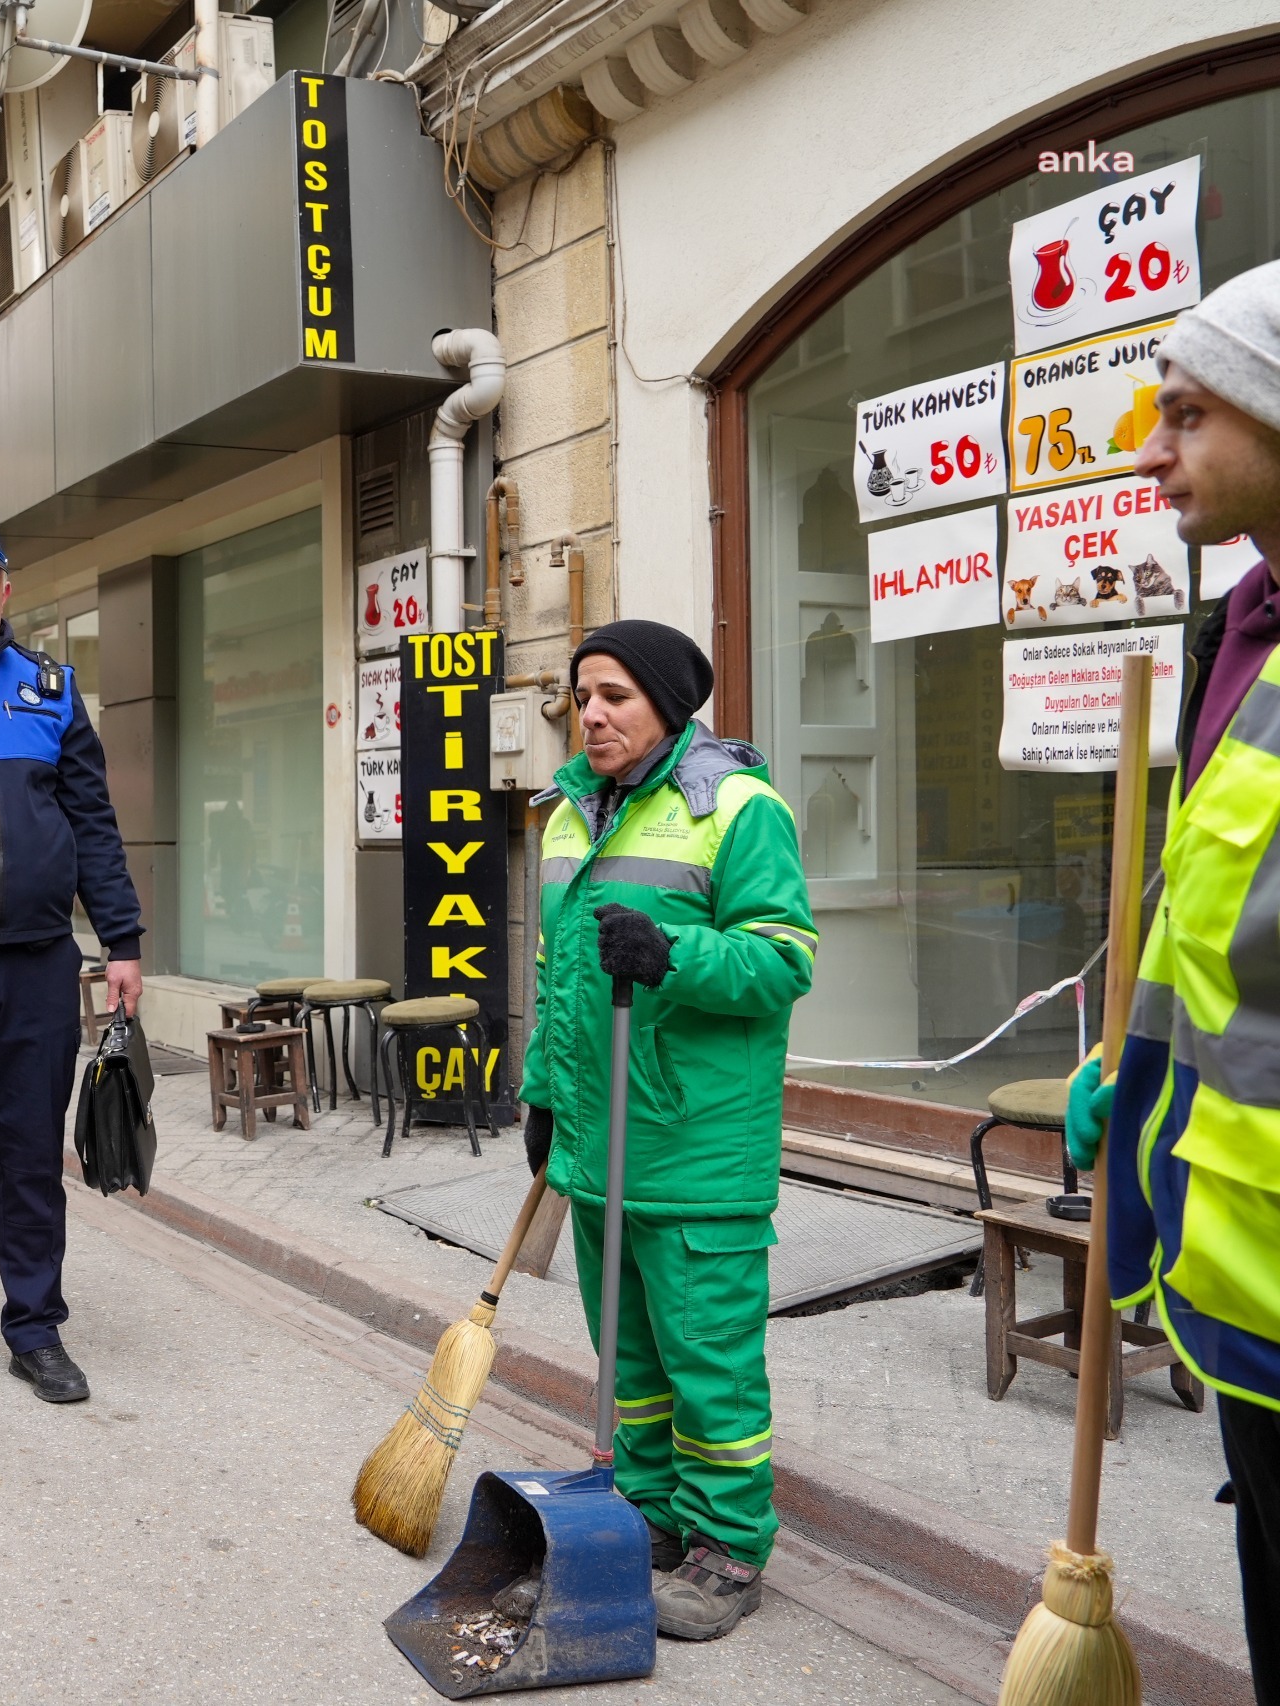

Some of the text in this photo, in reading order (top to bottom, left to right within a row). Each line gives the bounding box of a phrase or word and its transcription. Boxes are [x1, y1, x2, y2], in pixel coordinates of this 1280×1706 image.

[301, 76, 337, 360] TOSTÇUM
[1098, 180, 1177, 245] ÇAY
[1024, 333, 1166, 388] ORANGE JUIC
[862, 368, 997, 434] TÜRK KAHVESİ
[1015, 485, 1172, 533] YASAYI GER
[1064, 529, 1118, 568] ÇEK
[390, 561, 419, 592] ÇAY
[873, 552, 993, 601] IHLAMUR
[408, 631, 498, 679] TOST
[1022, 635, 1160, 661] Onlar Sadece Sokak Hayvanları Değil
[1048, 669, 1070, 684] Gelen
[1071, 667, 1099, 683] Haklara
[1101, 665, 1122, 682] Sahip
[1044, 695, 1081, 713] Duyguları
[1083, 693, 1099, 708] Olan
[1032, 721, 1060, 736] Onların
[1061, 718, 1095, 735] Hislerine
[1097, 723, 1106, 734] ve
[360, 756, 385, 776] TÜRK
[1022, 747, 1042, 763] Sahip
[1044, 745, 1074, 764] Çıkmak
[1076, 743, 1088, 760] İse
